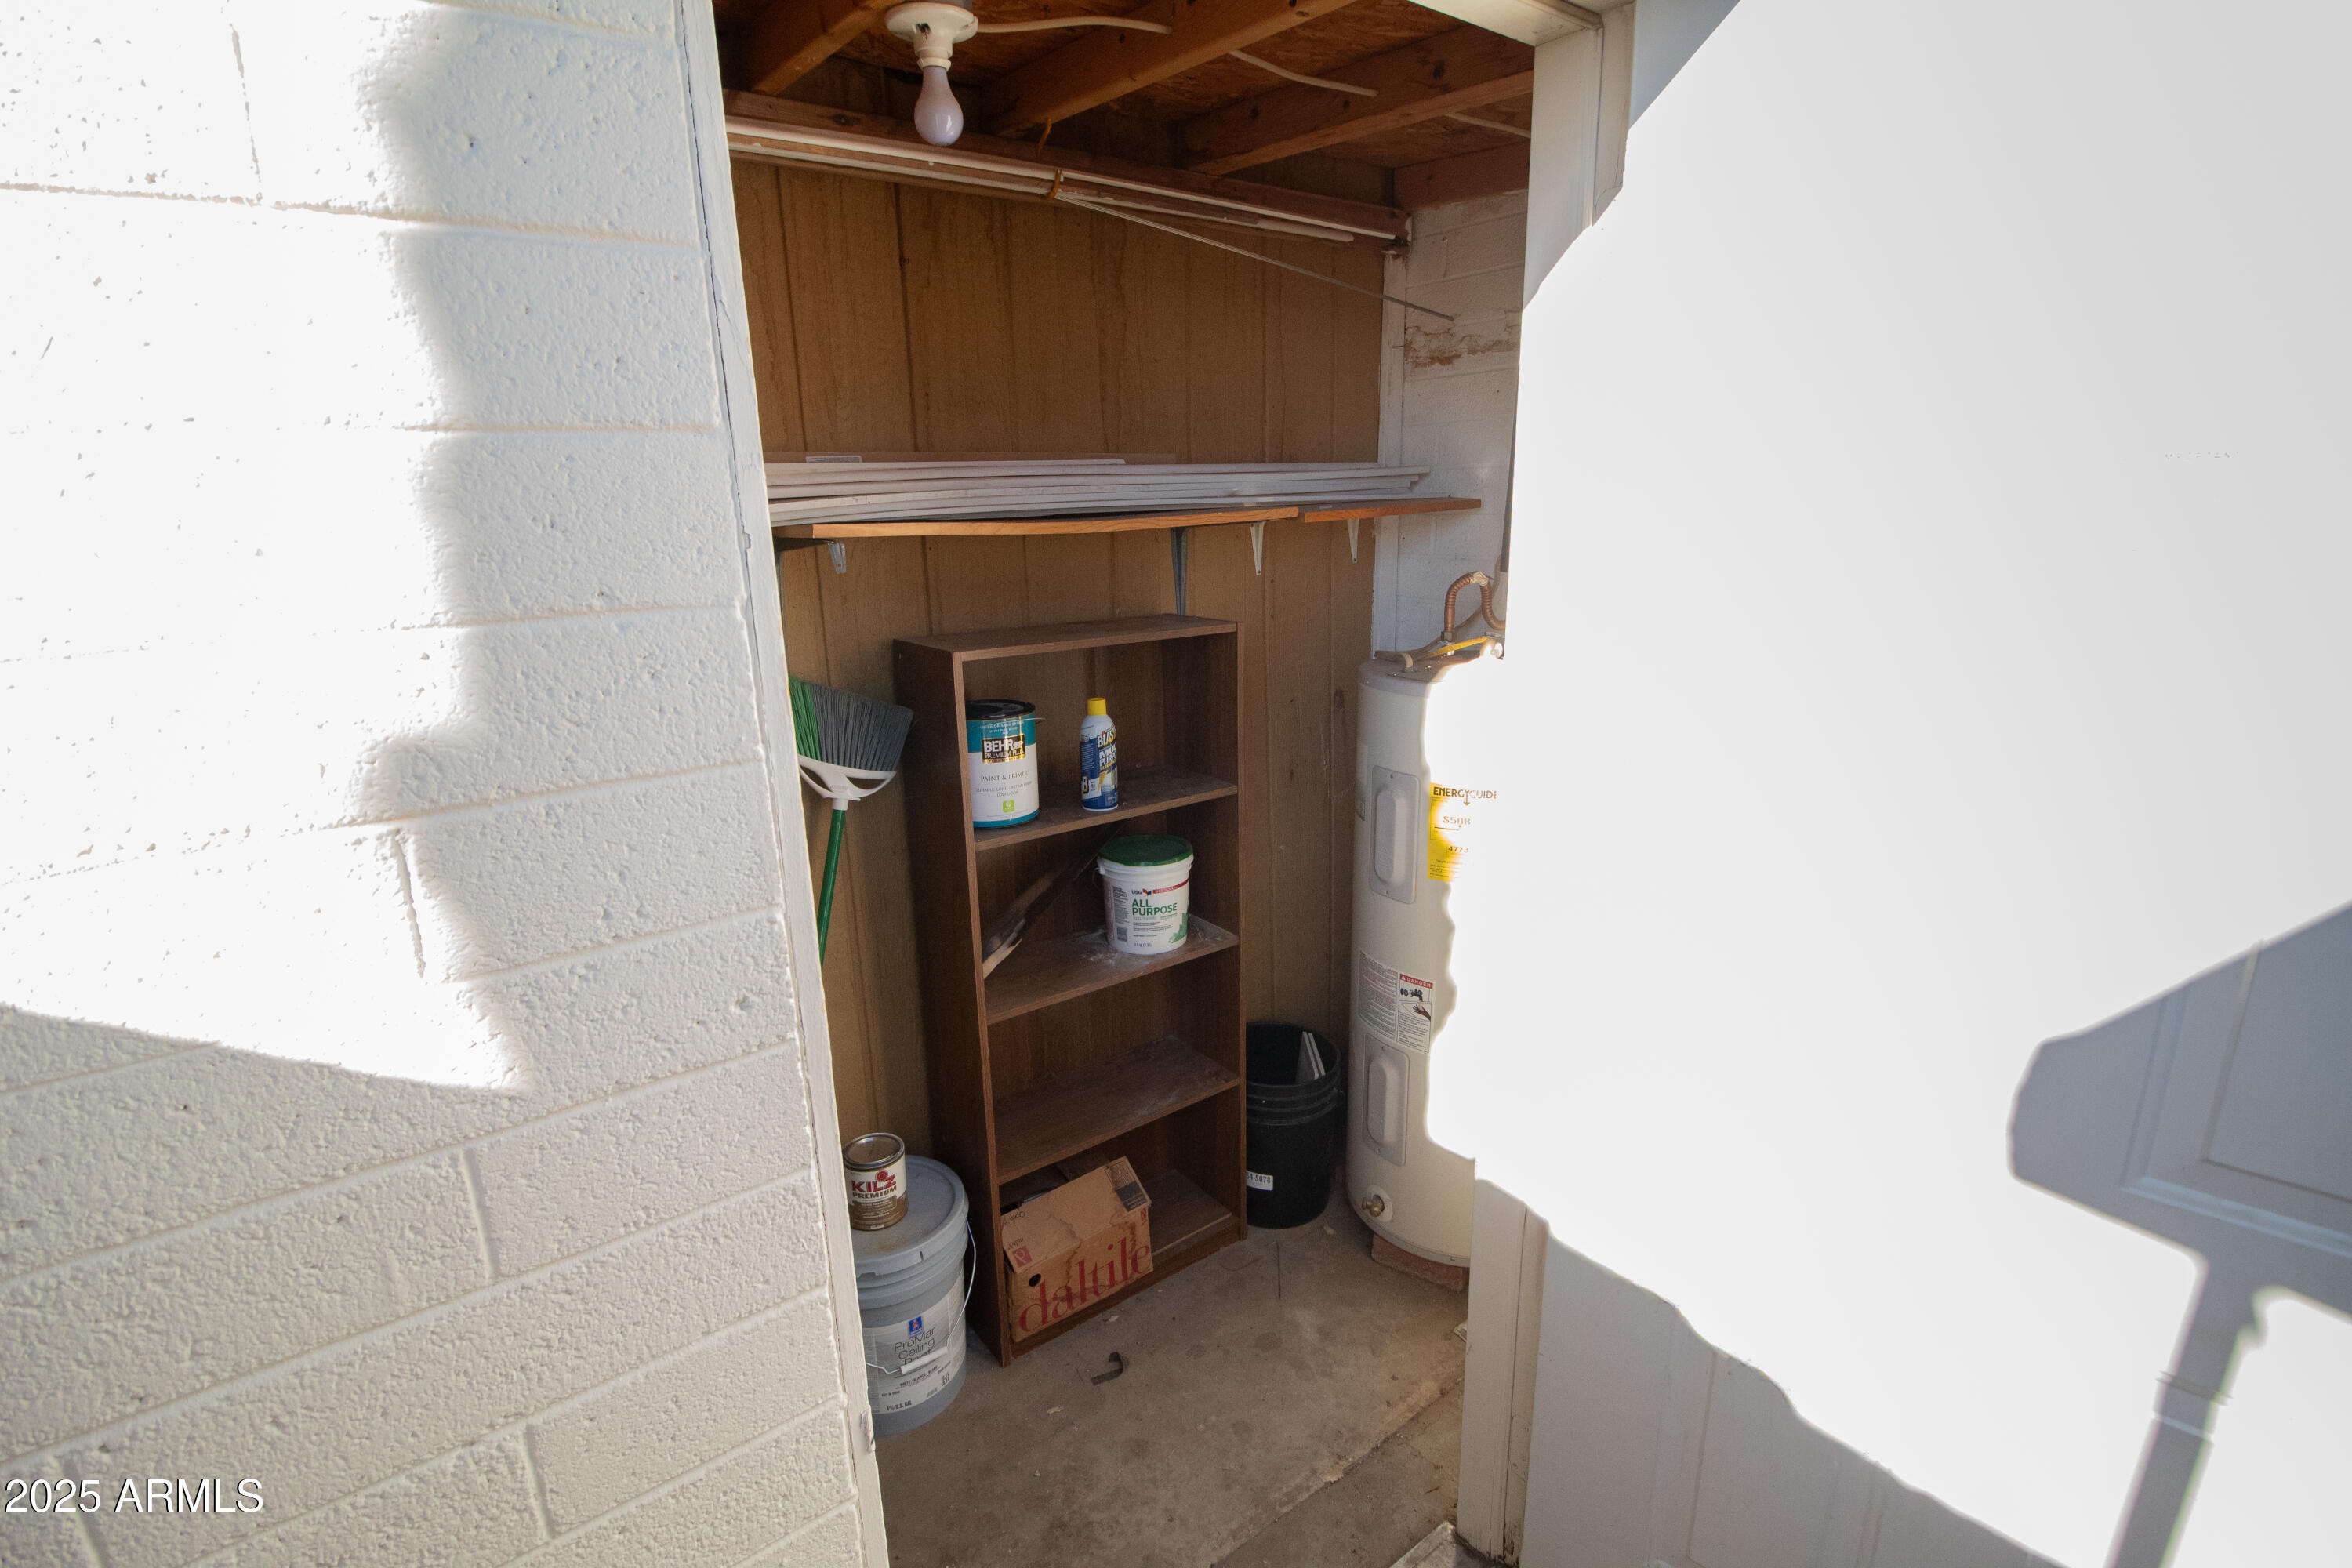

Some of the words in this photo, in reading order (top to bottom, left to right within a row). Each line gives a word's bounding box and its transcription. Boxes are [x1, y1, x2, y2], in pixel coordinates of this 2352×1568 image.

[984, 739, 1014, 753] BEHR
[984, 750, 1011, 759] PREMIUM
[1008, 771, 1029, 779] PRIMER
[1131, 898, 1152, 908] ALL
[1132, 902, 1178, 916] PURPOSE
[1406, 977, 1432, 988] DANGER
[851, 1173, 897, 1192] KILZ
[852, 1185, 897, 1199] PREMIUM
[1019, 1236, 1151, 1332] daltile
[894, 1327, 935, 1352] ProMar
[898, 1338, 935, 1360] Ceiling
